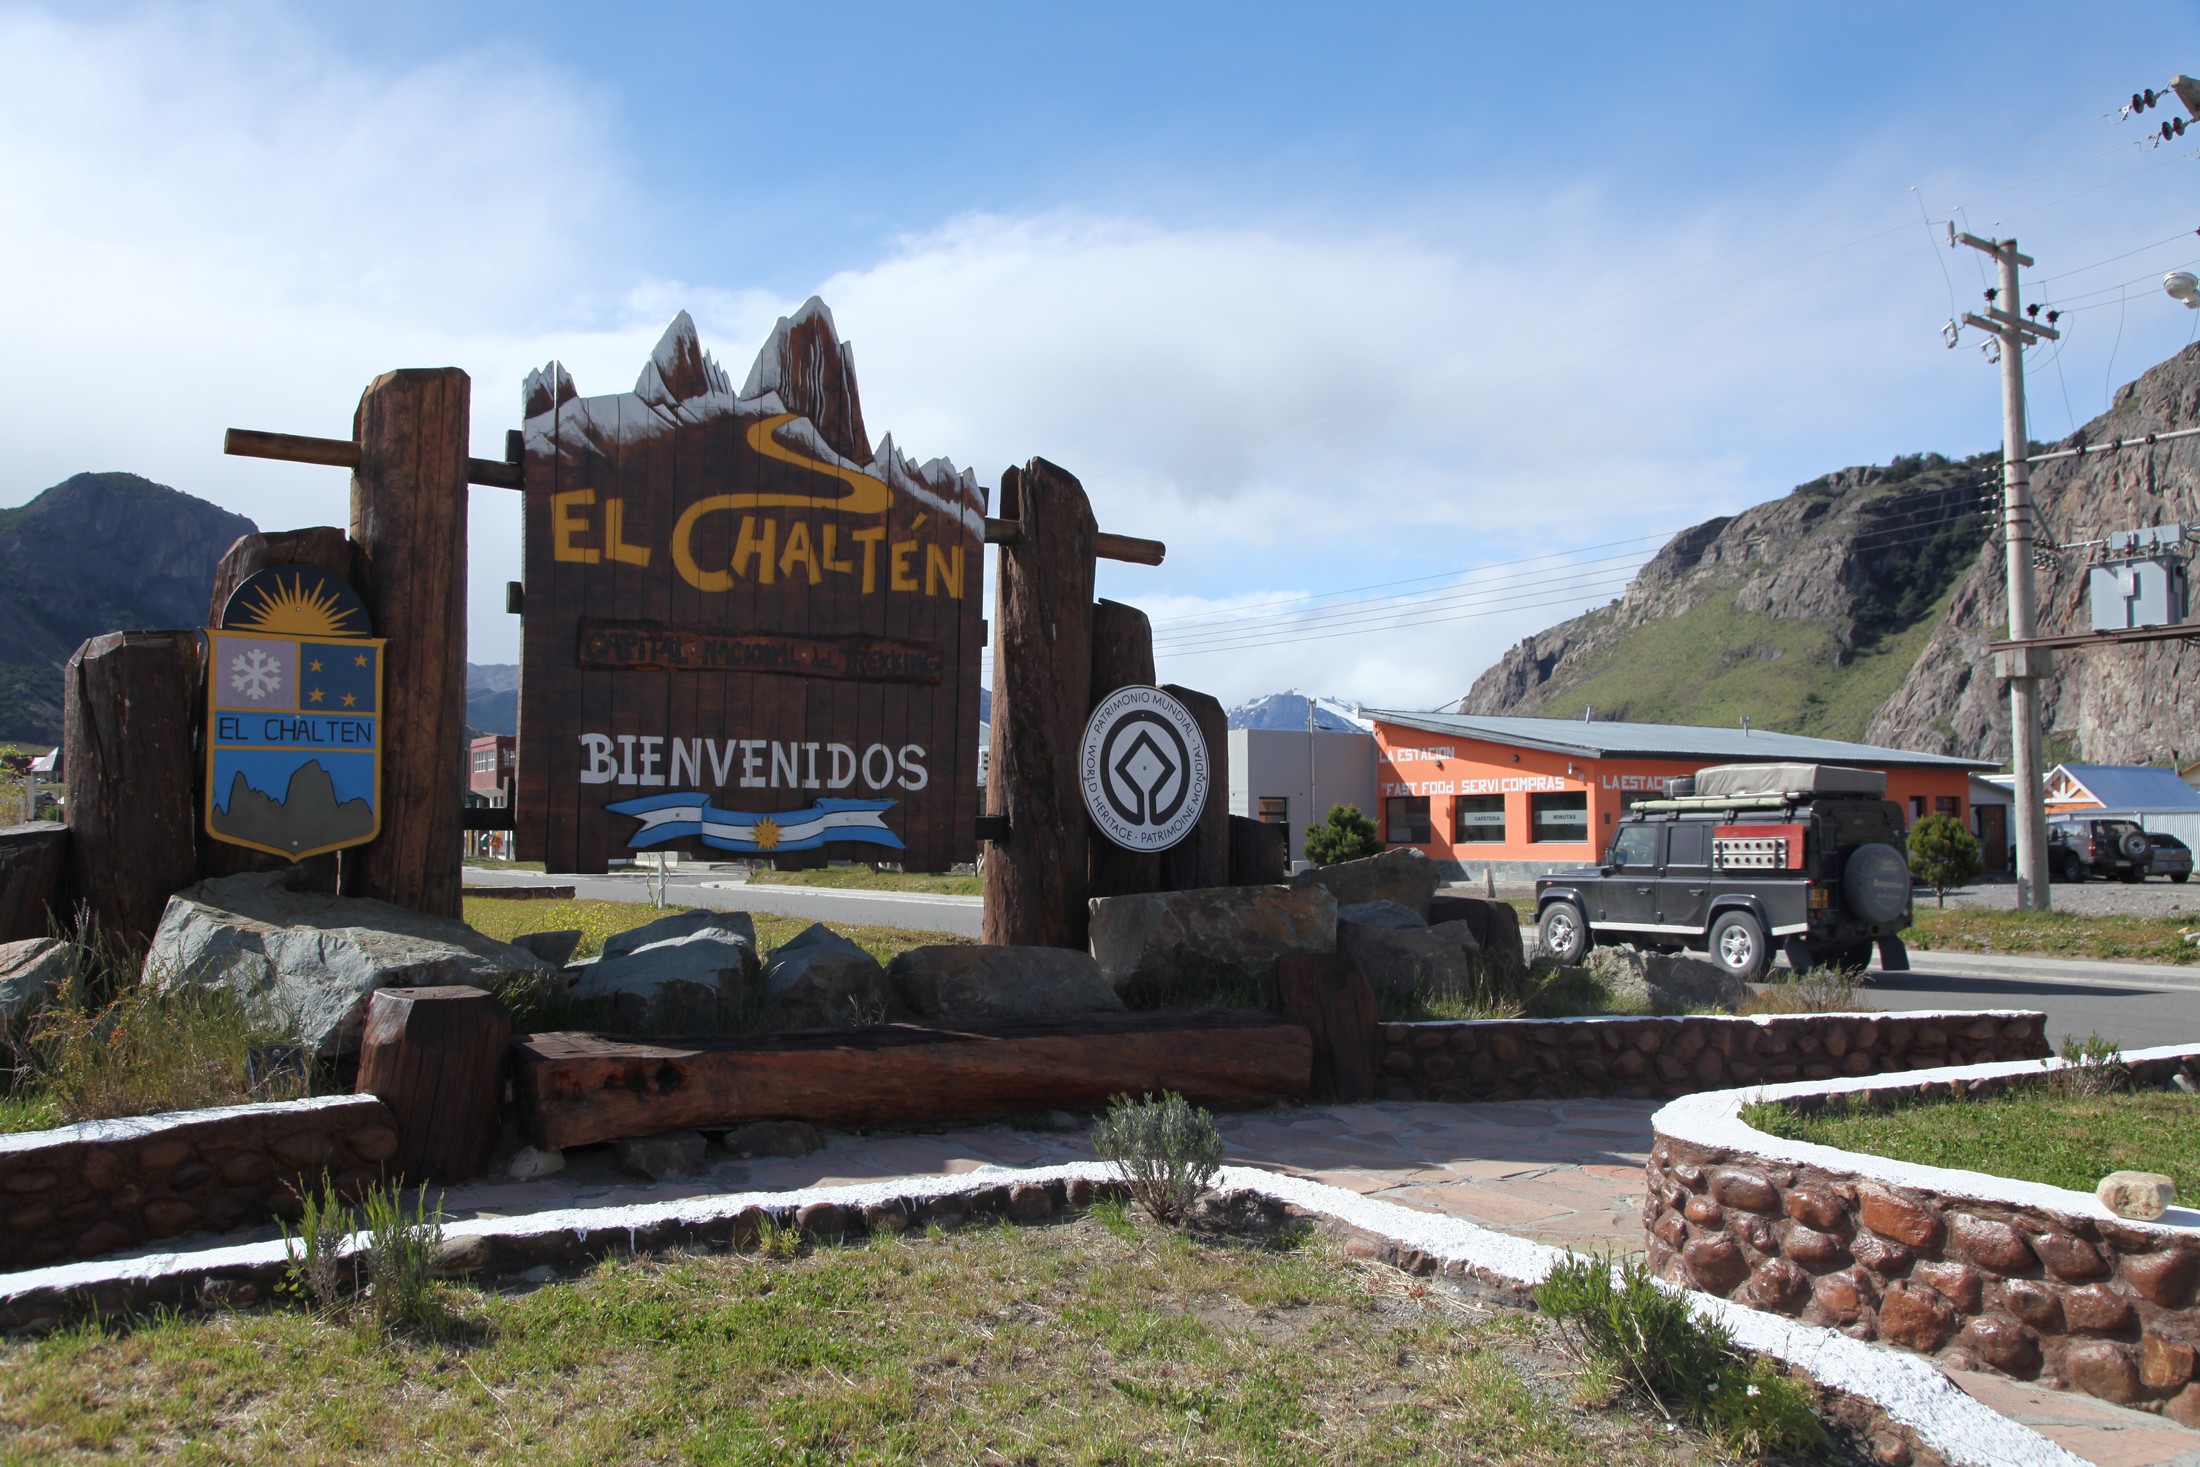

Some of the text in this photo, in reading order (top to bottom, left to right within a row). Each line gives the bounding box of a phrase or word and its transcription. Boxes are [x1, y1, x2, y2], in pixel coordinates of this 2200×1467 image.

[551, 488, 965, 599] EL CHALTÉN
[584, 631, 689, 665] CAPITAL
[703, 639, 801, 668] NACIONAL
[218, 717, 372, 743] EL CHALTEN
[1094, 692, 1195, 738] PATRIMONIO MUNDIAL
[578, 732, 929, 791] BIENVENIDOS
[1379, 746, 1455, 763] LA ESTACION
[1086, 745, 1132, 841] WORLD HERITAGE
[1141, 743, 1205, 843] PATRIMOINE MONDIAL
[1602, 775, 1677, 790] LA ESTAC
